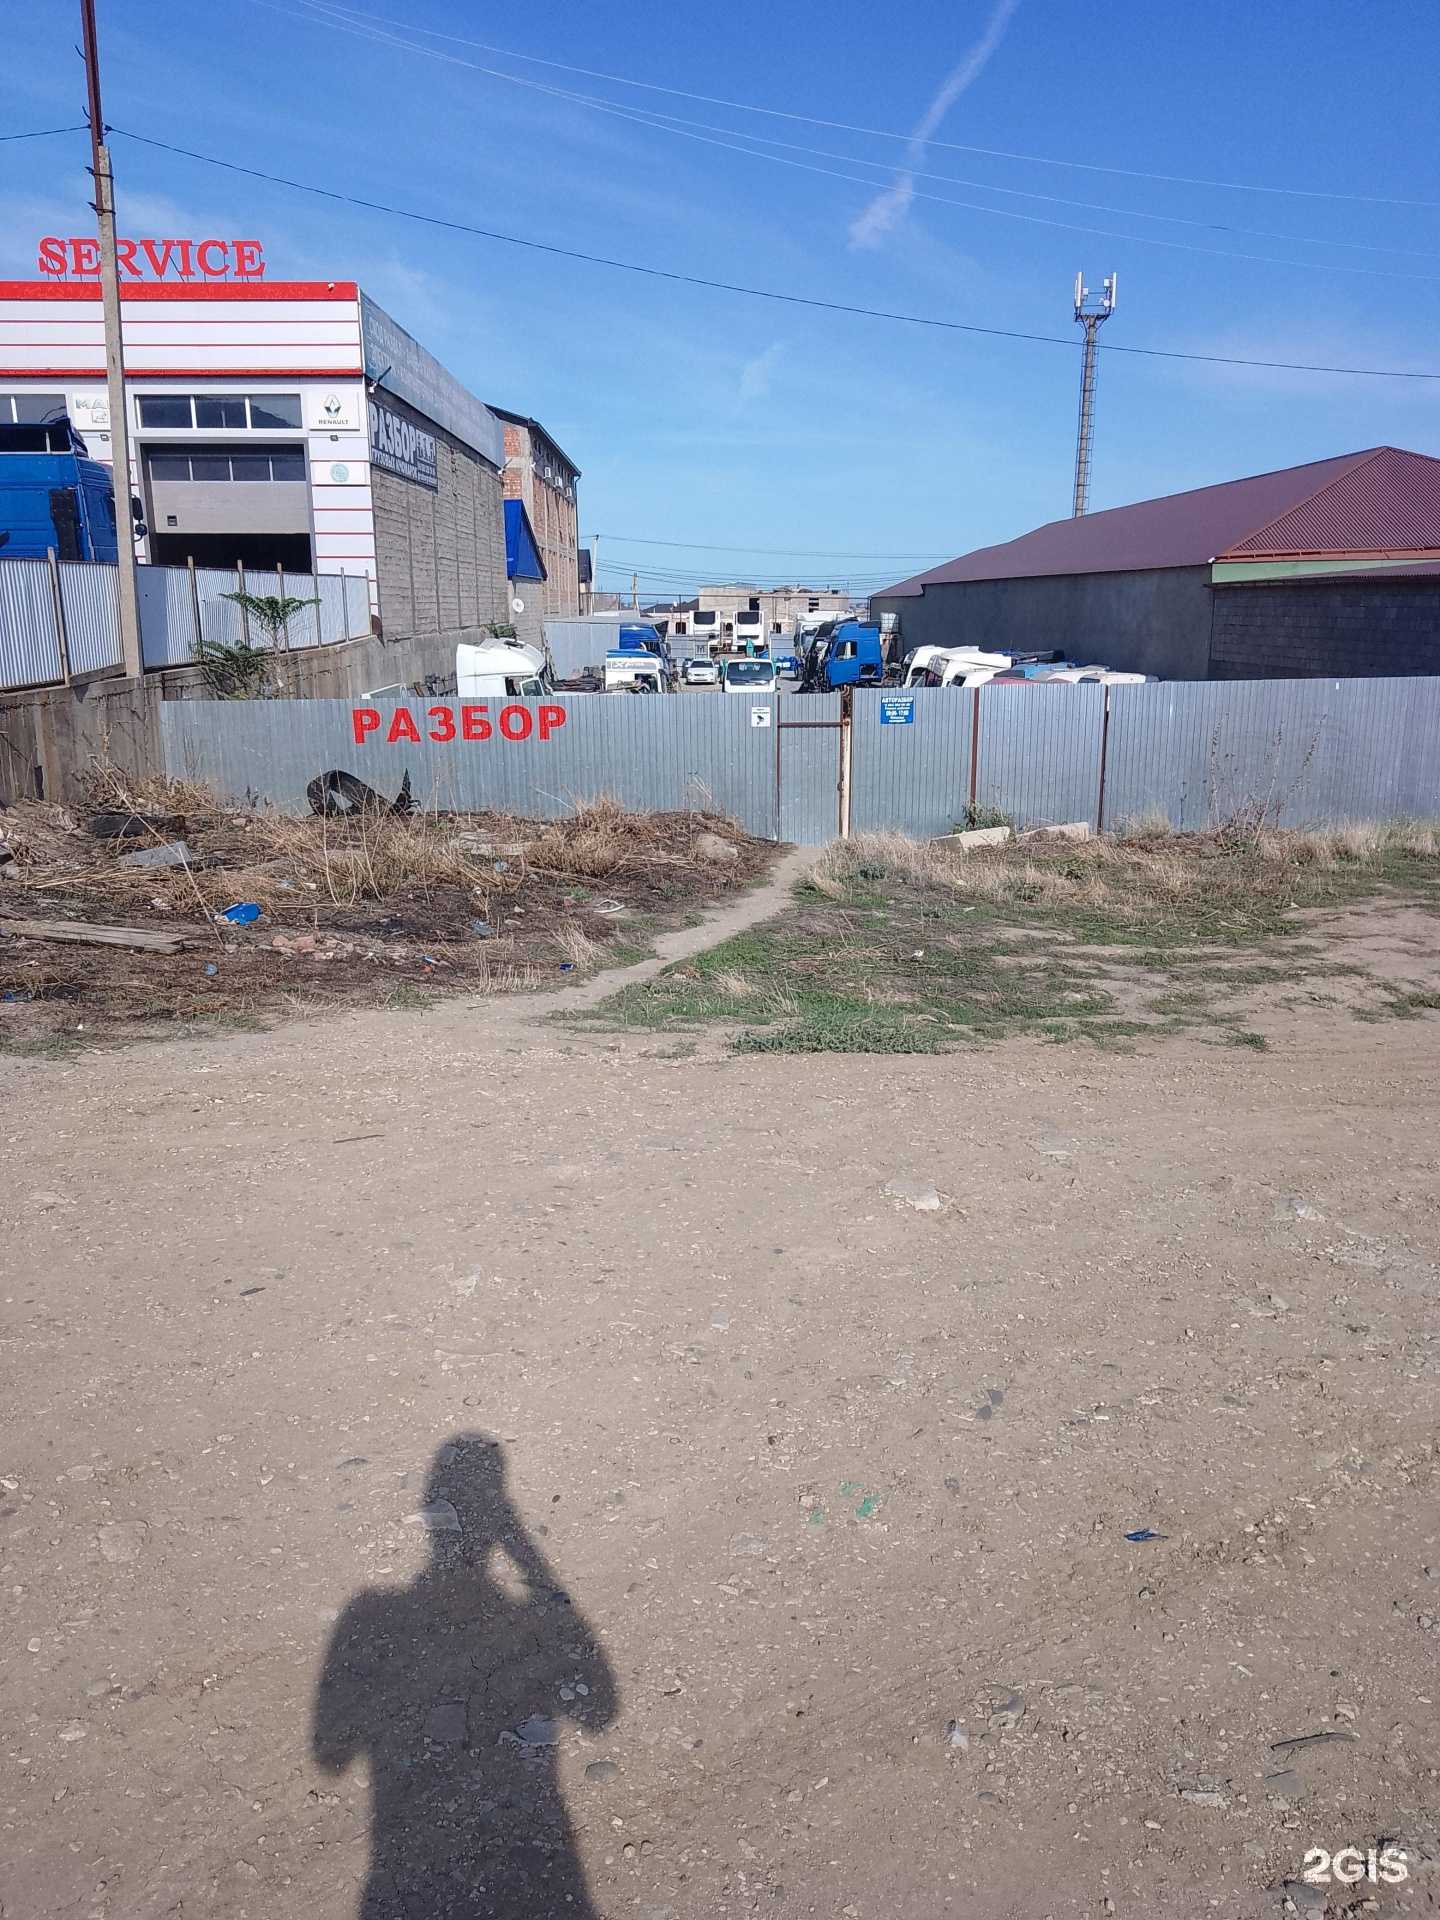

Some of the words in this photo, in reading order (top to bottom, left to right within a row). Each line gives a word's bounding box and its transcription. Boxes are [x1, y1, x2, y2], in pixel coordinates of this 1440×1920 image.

[38, 237, 266, 277] SERVICE
[76, 399, 110, 409] MA
[368, 401, 416, 464] РАЗБОР
[351, 704, 568, 744] РАЗБОР
